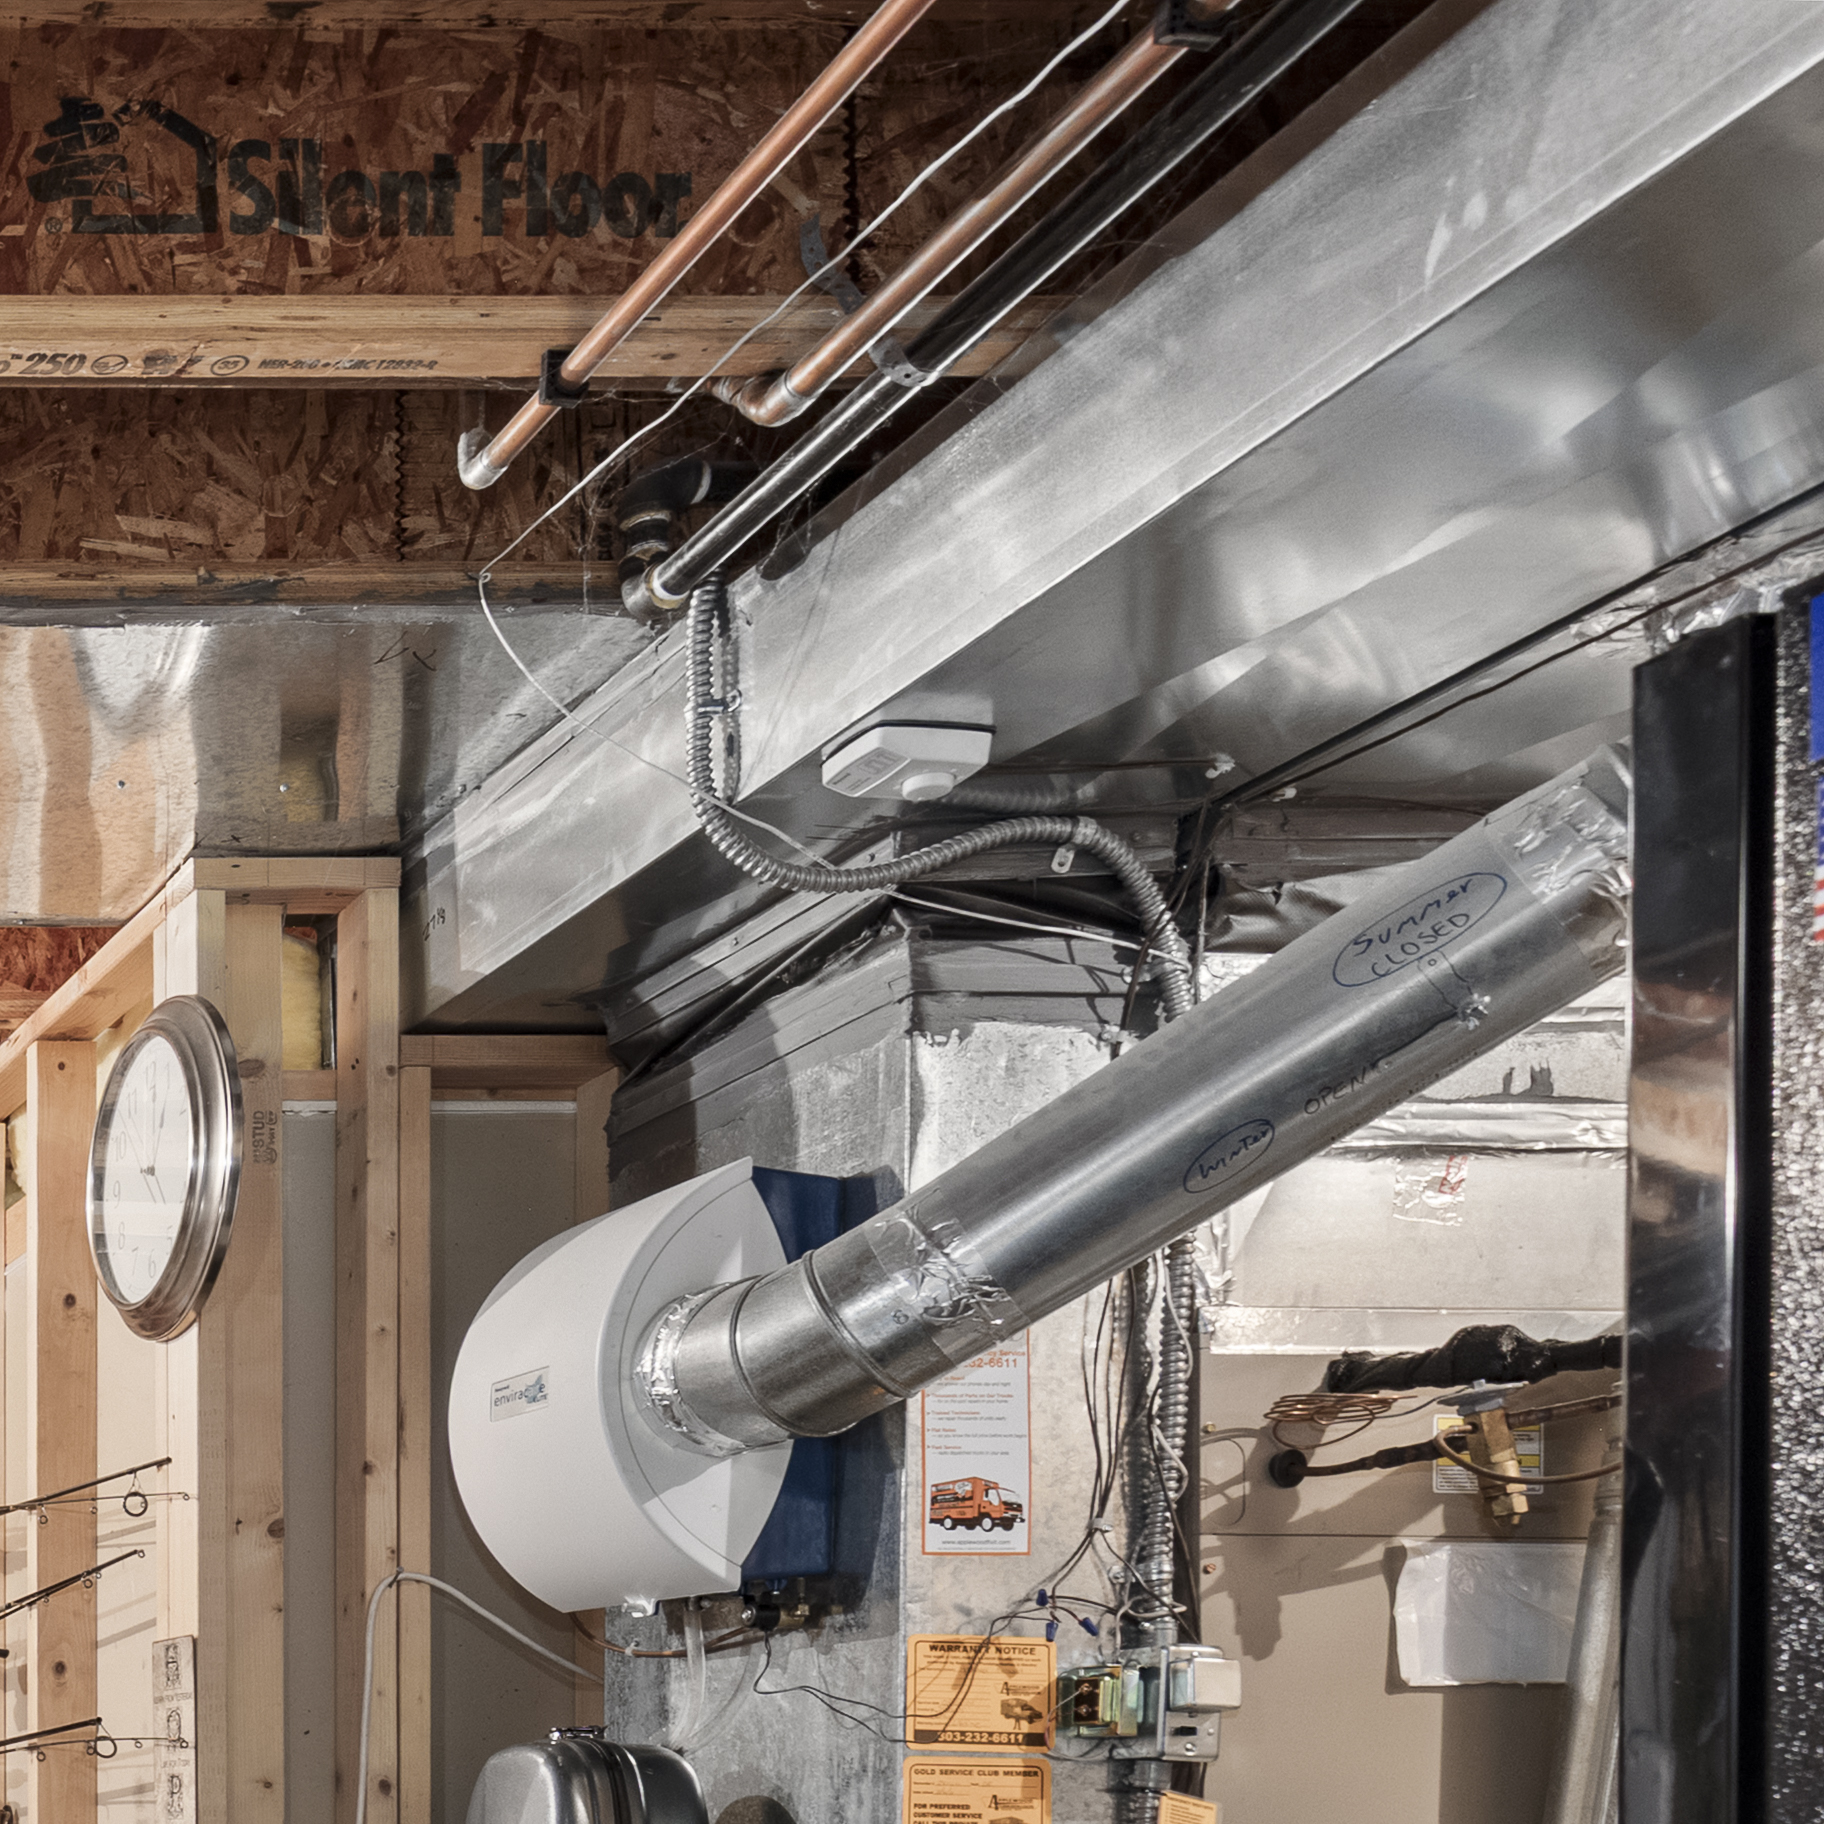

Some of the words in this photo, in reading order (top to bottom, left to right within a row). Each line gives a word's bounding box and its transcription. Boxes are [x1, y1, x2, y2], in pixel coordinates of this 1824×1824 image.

[223, 138, 455, 237] Silent
[480, 138, 693, 238] Floor
[26, 350, 88, 377] 250
[1370, 911, 1471, 978] CLOSED
[1304, 1073, 1365, 1116] OPEN
[113, 1131, 127, 1161] 10
[965, 1357, 1018, 1368] 32-6611
[929, 1643, 990, 1655] WARRANTY
[995, 1646, 1036, 1656] NOTICE
[937, 1731, 1024, 1744] 303-232-6611
[913, 1768, 936, 1777] GOLD
[939, 1768, 975, 1778] SERVICE
[977, 1769, 1000, 1779] CLUB
[1002, 1770, 1039, 1781] MEMBER
